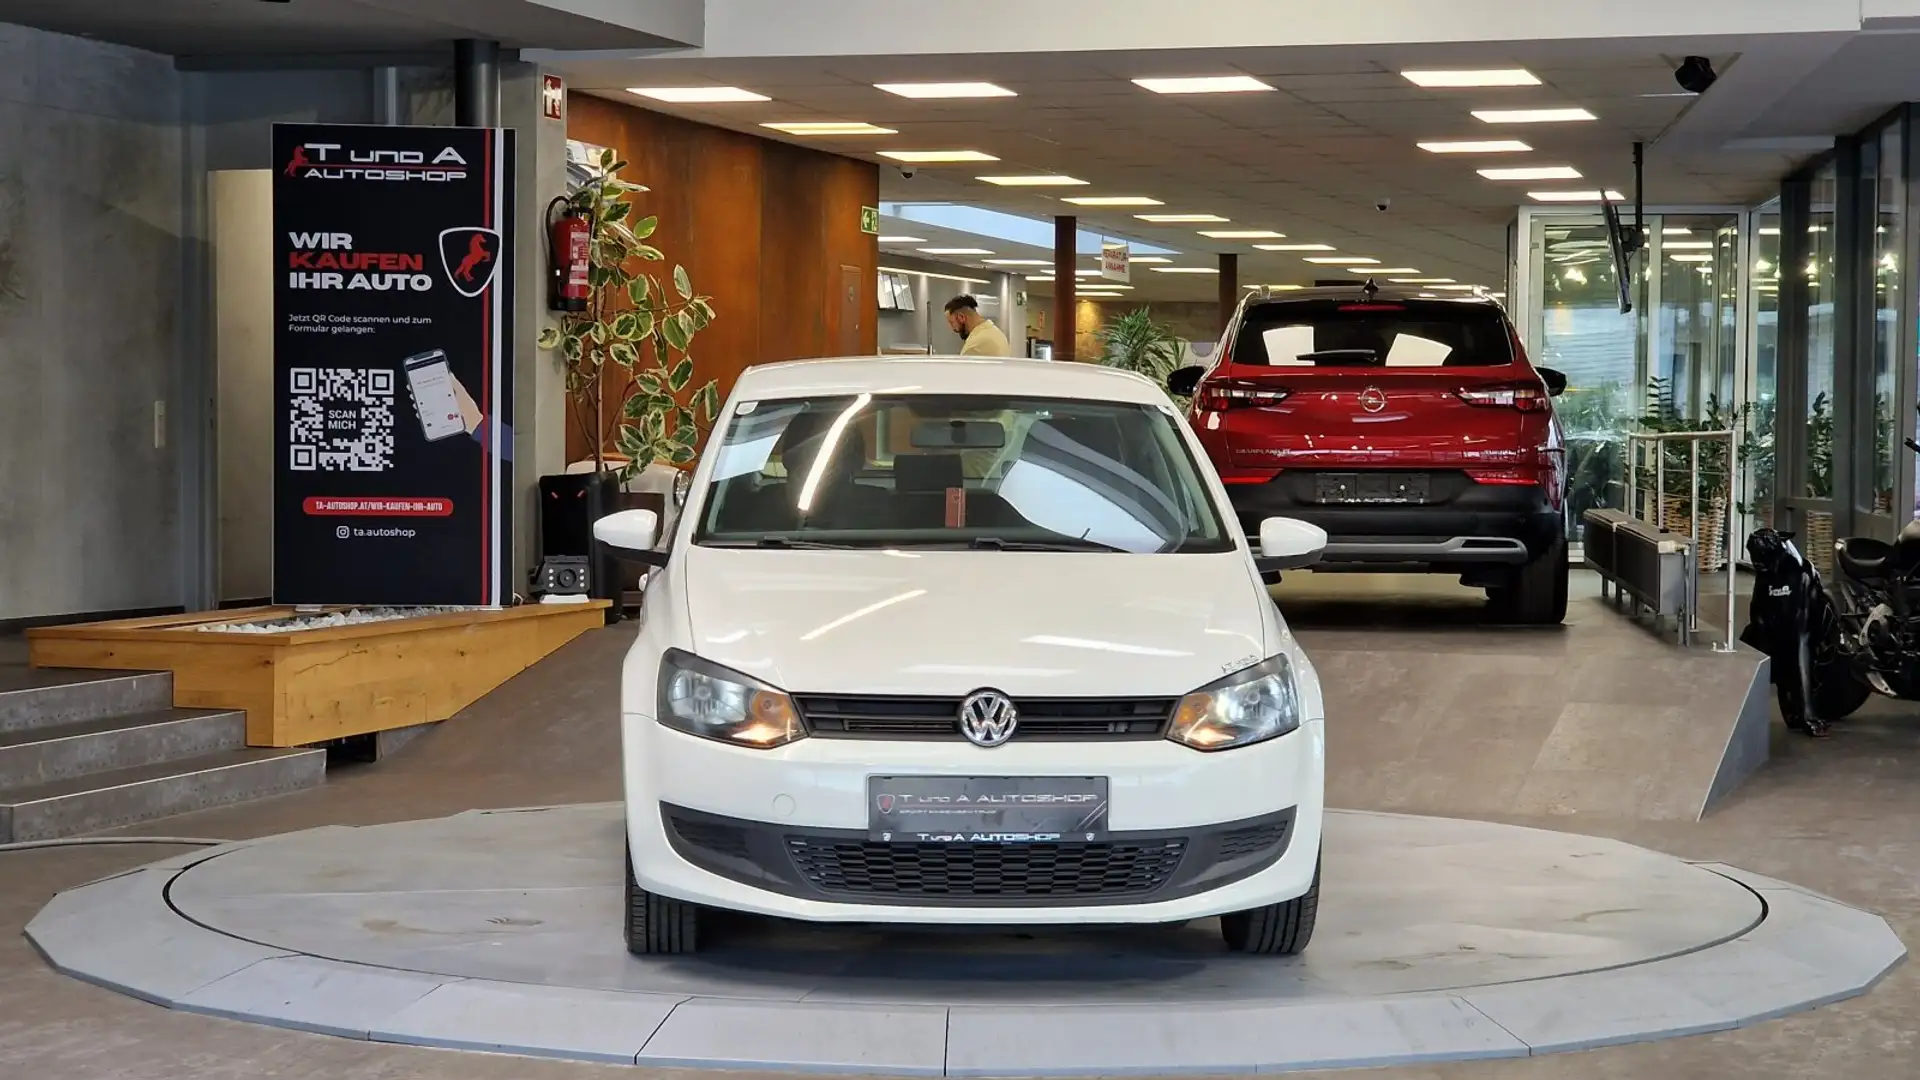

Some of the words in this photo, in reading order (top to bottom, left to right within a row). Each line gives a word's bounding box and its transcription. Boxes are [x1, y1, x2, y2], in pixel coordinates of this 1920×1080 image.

[304, 143, 341, 161] T
[431, 146, 467, 165] A
[304, 168, 467, 182] AUTOSHOP
[288, 231, 353, 250] WIR
[289, 252, 423, 271] KAUFEN
[289, 272, 344, 290] IHR
[346, 273, 433, 291] AUTO
[288, 314, 310, 323] Jetzt
[312, 314, 327, 323] QR
[328, 314, 351, 323] Code
[392, 315, 411, 324] und
[288, 324, 329, 333] Formular
[331, 325, 376, 335] gelangen:
[328, 410, 357, 419] SCAN
[328, 420, 357, 430] MICH
[353, 527, 416, 538] ta.autoshop
[898, 794, 914, 803] T
[955, 794, 971, 803] A
[976, 794, 1098, 803] AUTOSHOP
[970, 833, 1061, 841] AUTOSHOP
